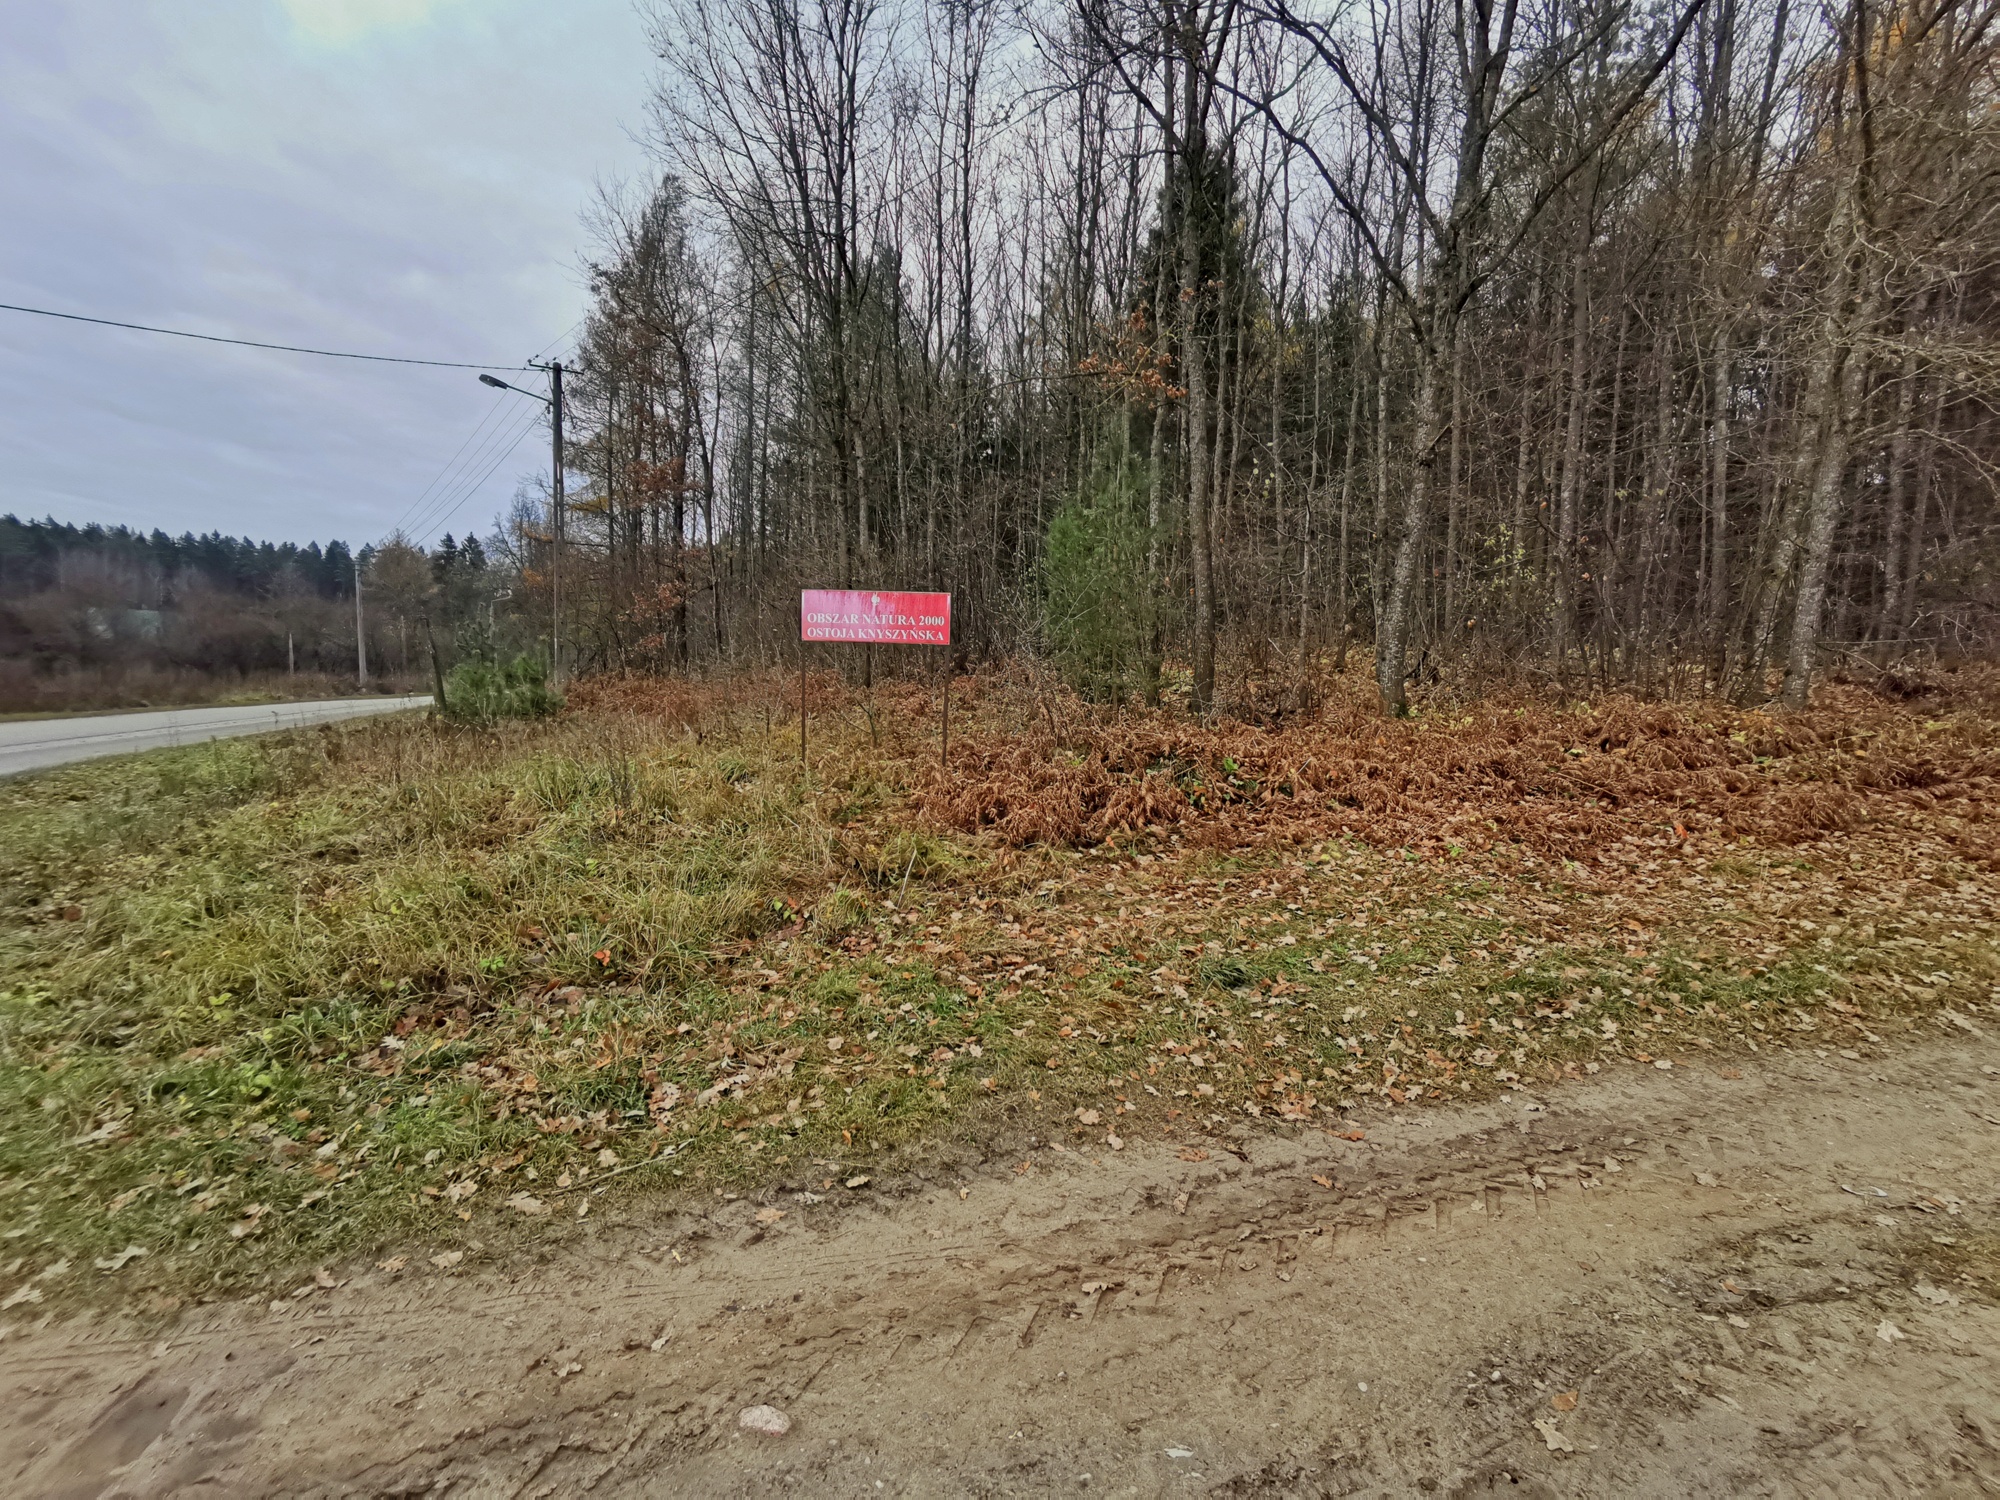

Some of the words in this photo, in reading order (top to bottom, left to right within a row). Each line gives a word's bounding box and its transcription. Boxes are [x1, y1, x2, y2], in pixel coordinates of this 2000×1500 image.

[807, 613, 859, 624] OBSZAR
[862, 614, 916, 625] NATURA
[918, 615, 945, 626] 2000
[807, 627, 855, 639] OSTOJA
[858, 627, 944, 641] KNYSZYŃSKA
